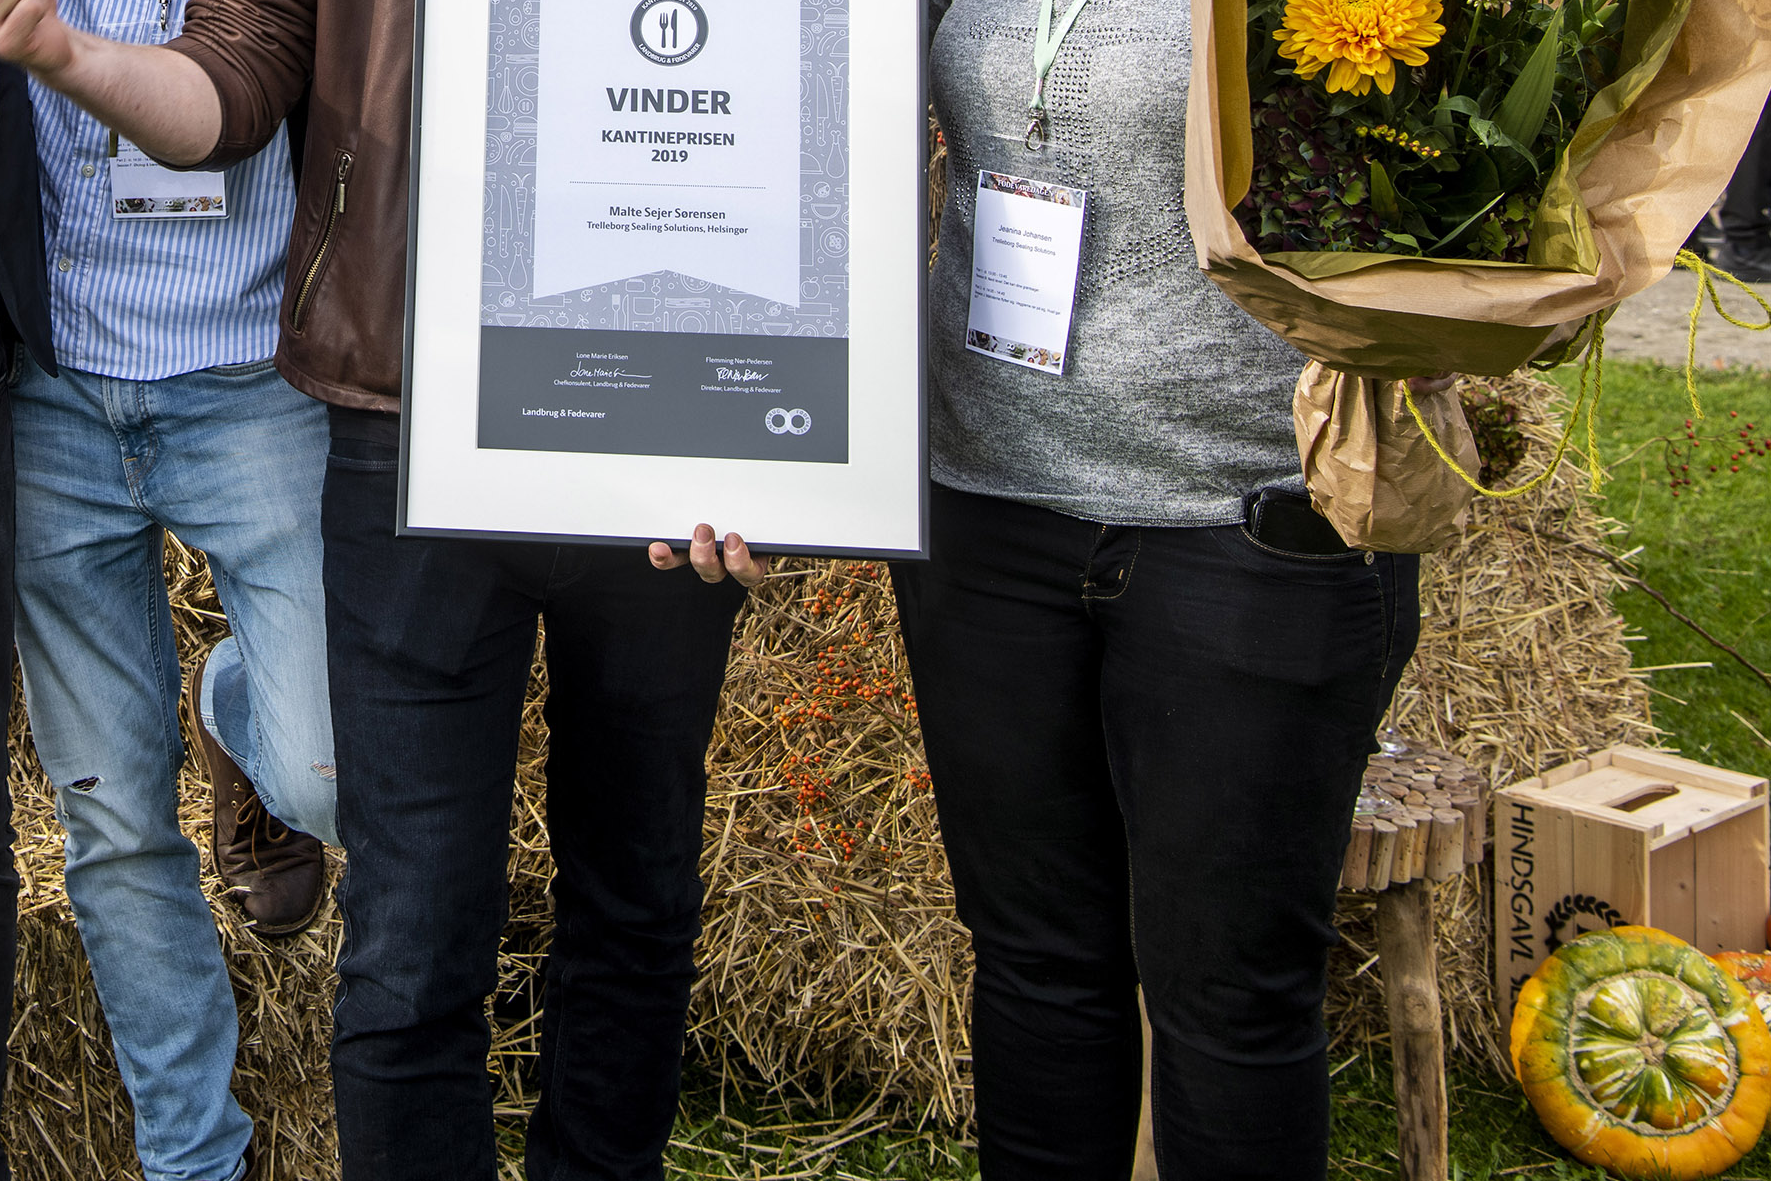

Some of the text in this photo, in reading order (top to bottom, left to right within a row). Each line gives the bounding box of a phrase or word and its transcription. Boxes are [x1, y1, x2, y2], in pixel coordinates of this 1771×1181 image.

[685, 0, 698, 11] 2019
[638, 43, 666, 63] LANDBRUG
[606, 87, 731, 115] VINDER
[601, 129, 735, 146] KANTINEPRISEN
[651, 149, 689, 163] 2019
[609, 206, 726, 220] Malte Sejer Sørensen
[587, 221, 749, 235] Trelleborg Sealing Solutions, Helsingør
[522, 407, 606, 419] Landbrug & Fødevarer
[1510, 802, 1534, 962] HINDSGAVL
